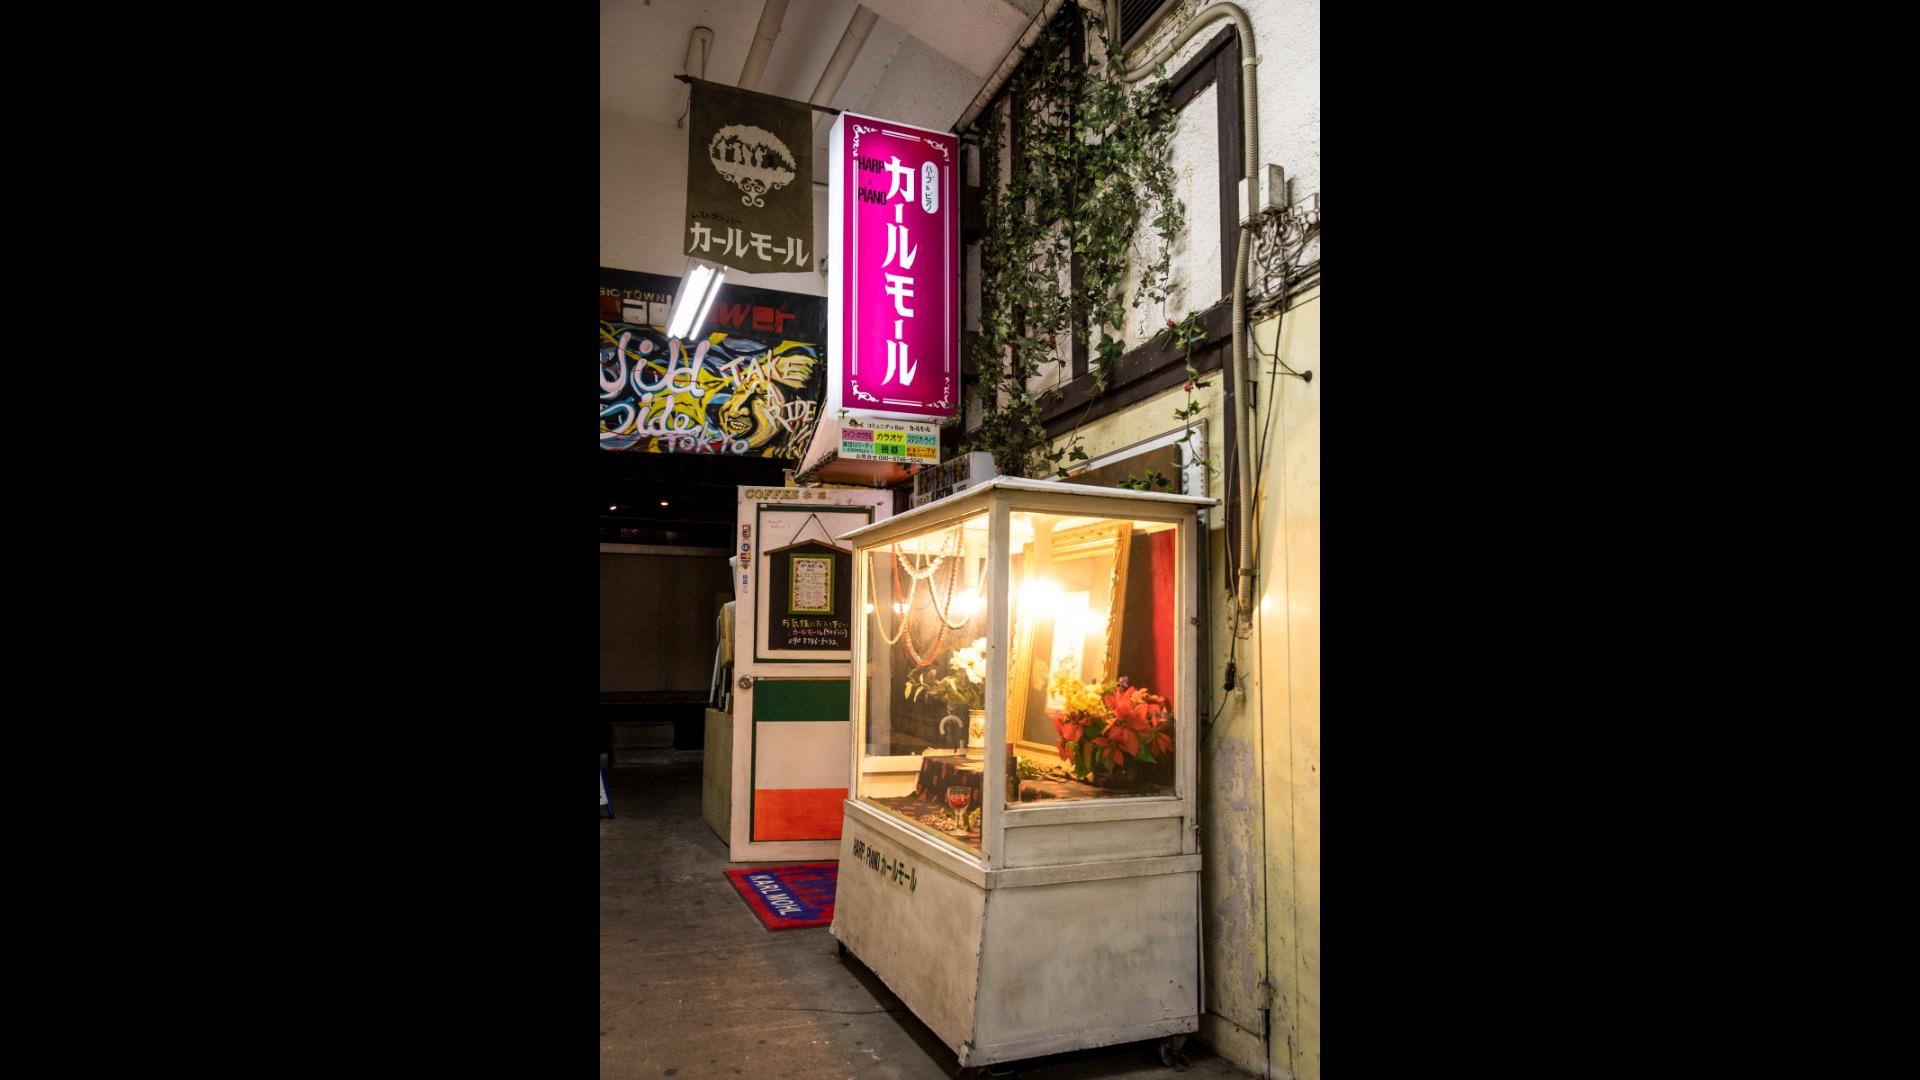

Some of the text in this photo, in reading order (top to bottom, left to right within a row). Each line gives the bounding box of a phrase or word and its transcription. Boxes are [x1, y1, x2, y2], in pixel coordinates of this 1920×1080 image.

[857, 156, 885, 174] HARP
[688, 221, 810, 267] カールモール
[880, 155, 918, 387] カールモール
[719, 349, 812, 388] TAKE
[876, 432, 904, 442] カラオケ
[744, 488, 800, 500] COFFEE
[749, 875, 783, 895] KARL
[880, 855, 918, 892] カールモール
